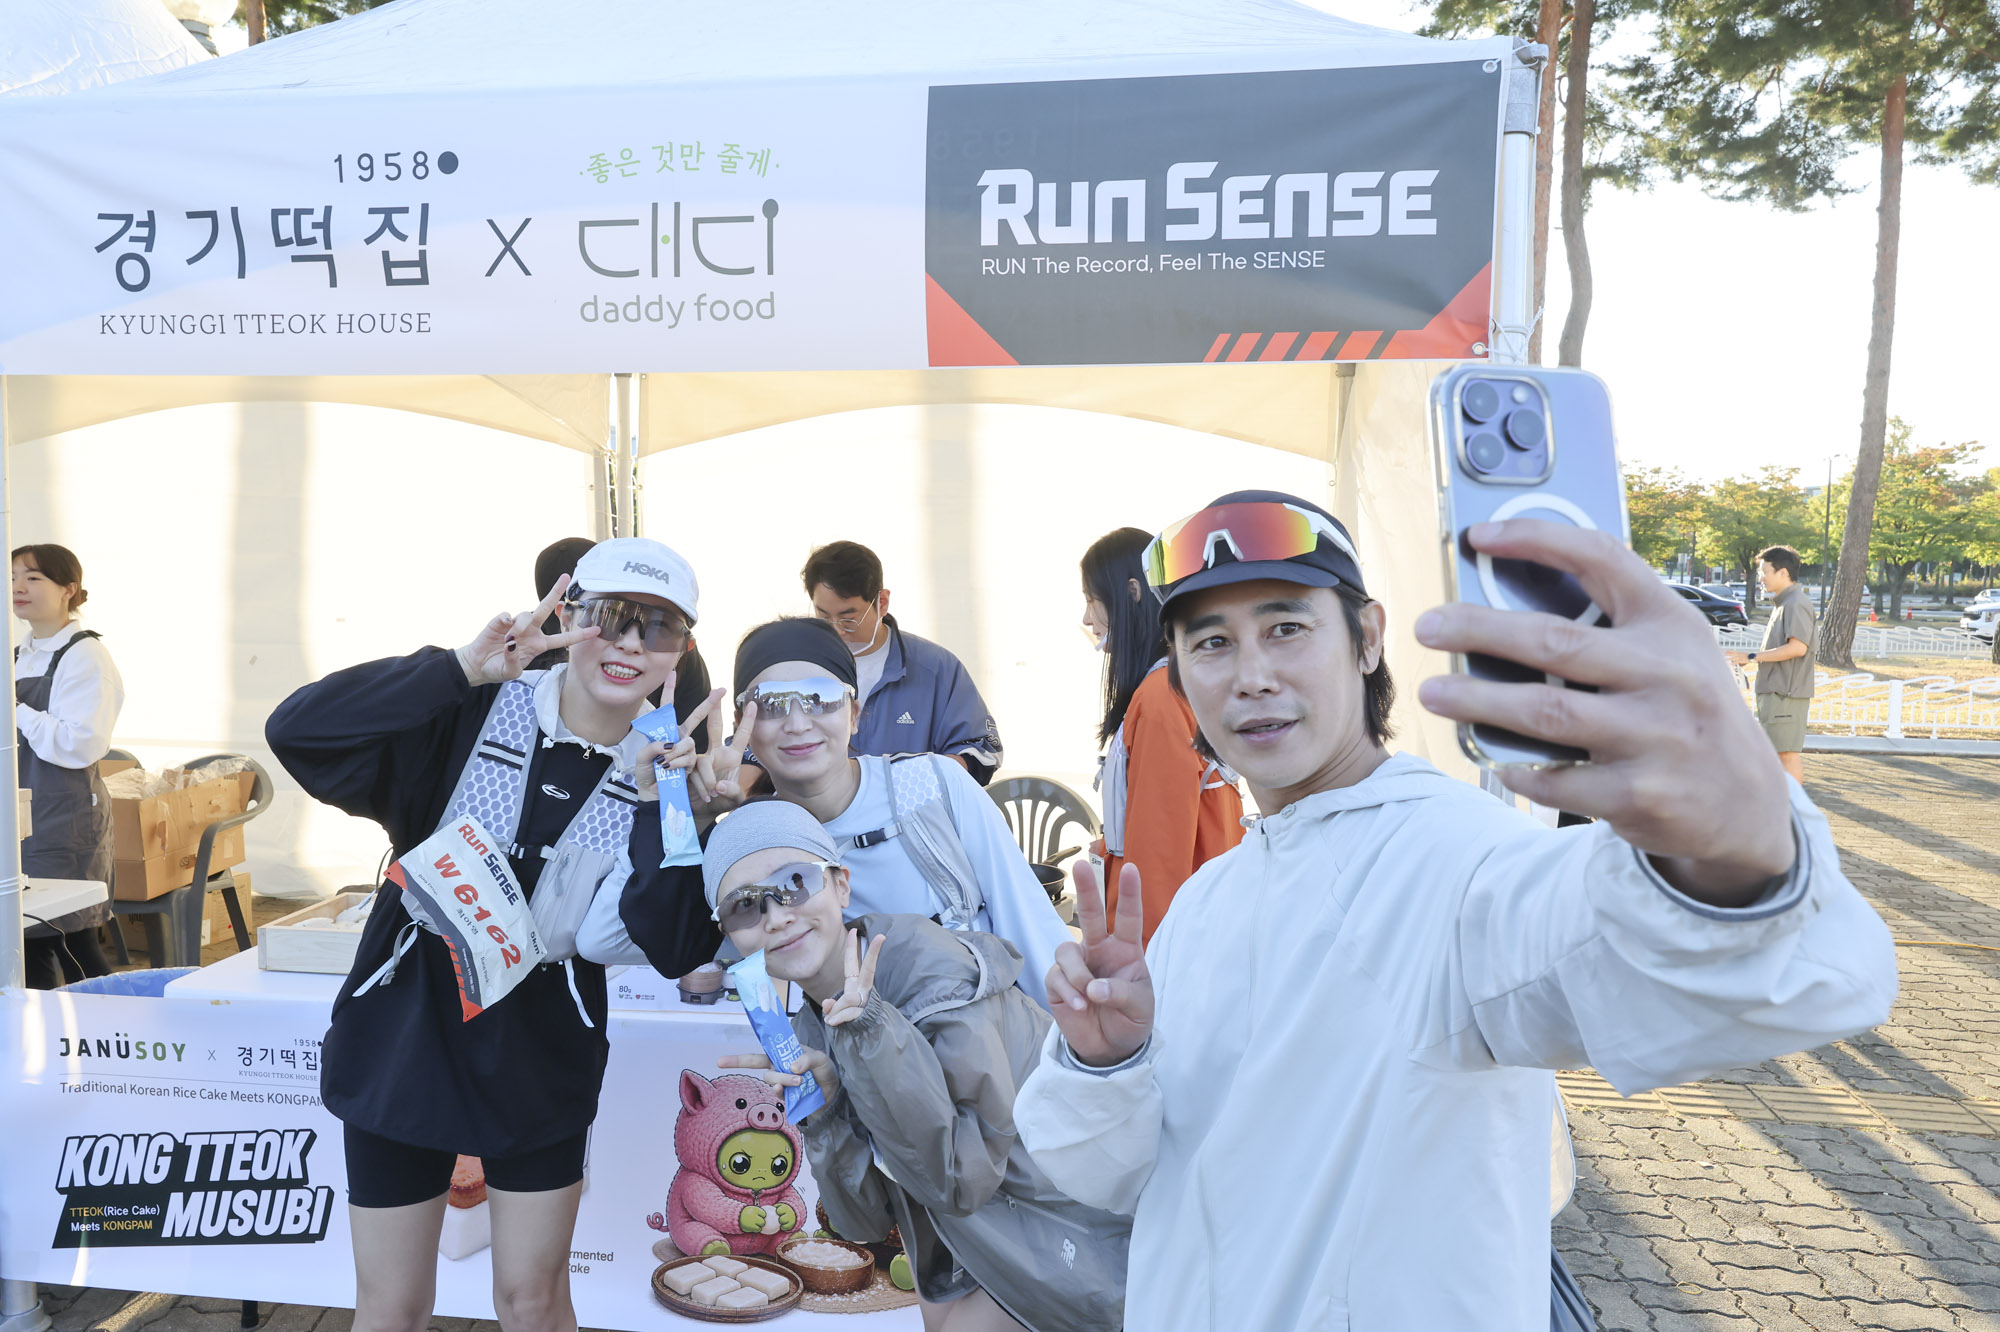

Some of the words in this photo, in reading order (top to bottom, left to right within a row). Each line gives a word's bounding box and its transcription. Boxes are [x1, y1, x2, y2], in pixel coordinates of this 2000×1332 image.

[334, 151, 430, 183] 1958
[652, 141, 705, 173] 것만
[94, 203, 430, 292] 경기떡집
[981, 256, 1025, 275] RUN
[1033, 256, 1070, 274] The
[1076, 254, 1153, 275] Record,
[1160, 253, 1201, 271] Feel
[1208, 252, 1247, 270] The
[1253, 250, 1325, 270] SENSE
[580, 294, 685, 329] daddy
[694, 291, 775, 321] food
[100, 314, 226, 335] KYUNGGI
[234, 313, 327, 334] TTEOK
[336, 313, 431, 333] HOUSE
[623, 561, 669, 584] HOKA
[530, 931, 540, 955] 5km
[618, 985, 632, 993] 80g
[59, 1032, 186, 1062] JANÜSOY
[294, 1039, 316, 1047] 1958
[237, 1047, 318, 1070] 경기떡집
[239, 1070, 271, 1078] KYUNGGI
[60, 1082, 127, 1095] Traditional
[130, 1084, 170, 1097] Korean
[173, 1085, 197, 1099] Rice
[200, 1088, 228, 1101] Cake
[230, 1090, 264, 1103] Meets
[57, 1133, 175, 1189] KONG
[183, 1130, 312, 1183] TTEOK
[70, 1205, 129, 1217] TTEOK(Rice
[131, 1204, 160, 1216] Cake)
[161, 1188, 330, 1238] MUSUBI
[71, 1221, 100, 1231] Meets
[103, 1220, 153, 1231] KONGPAM
[569, 1251, 614, 1262] rmented
